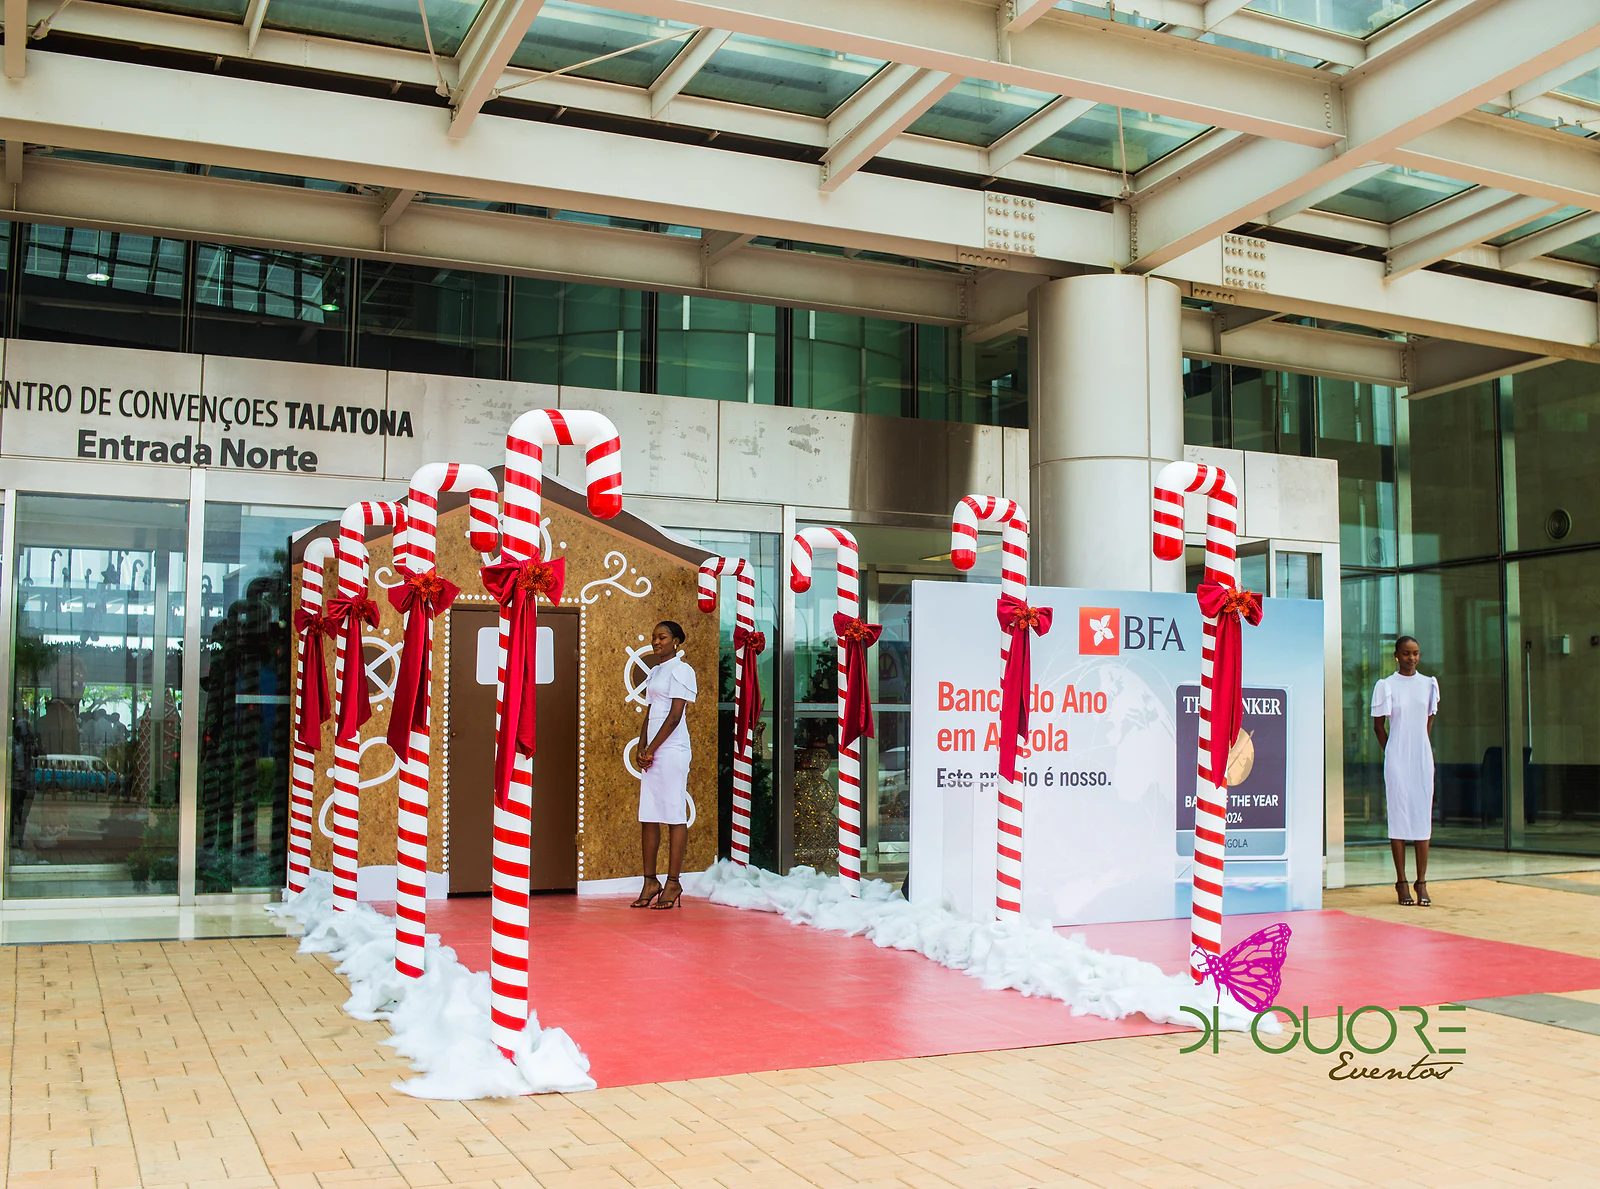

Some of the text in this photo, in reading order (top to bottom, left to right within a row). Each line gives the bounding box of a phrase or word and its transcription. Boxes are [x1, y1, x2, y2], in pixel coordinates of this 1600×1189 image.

[0, 381, 414, 437] NTRO DE CONVENÇOES TALATONA
[77, 429, 318, 472] Entrada Norte
[1124, 615, 1186, 652] BFA
[938, 681, 1108, 714] Banc do Ano
[1241, 697, 1282, 715] NKER
[937, 727, 976, 752] em
[936, 766, 1112, 792] Este prio é nosso.
[1230, 795, 1251, 808] THE
[1252, 794, 1279, 807] YEAR
[1224, 838, 1249, 849] GOLA
